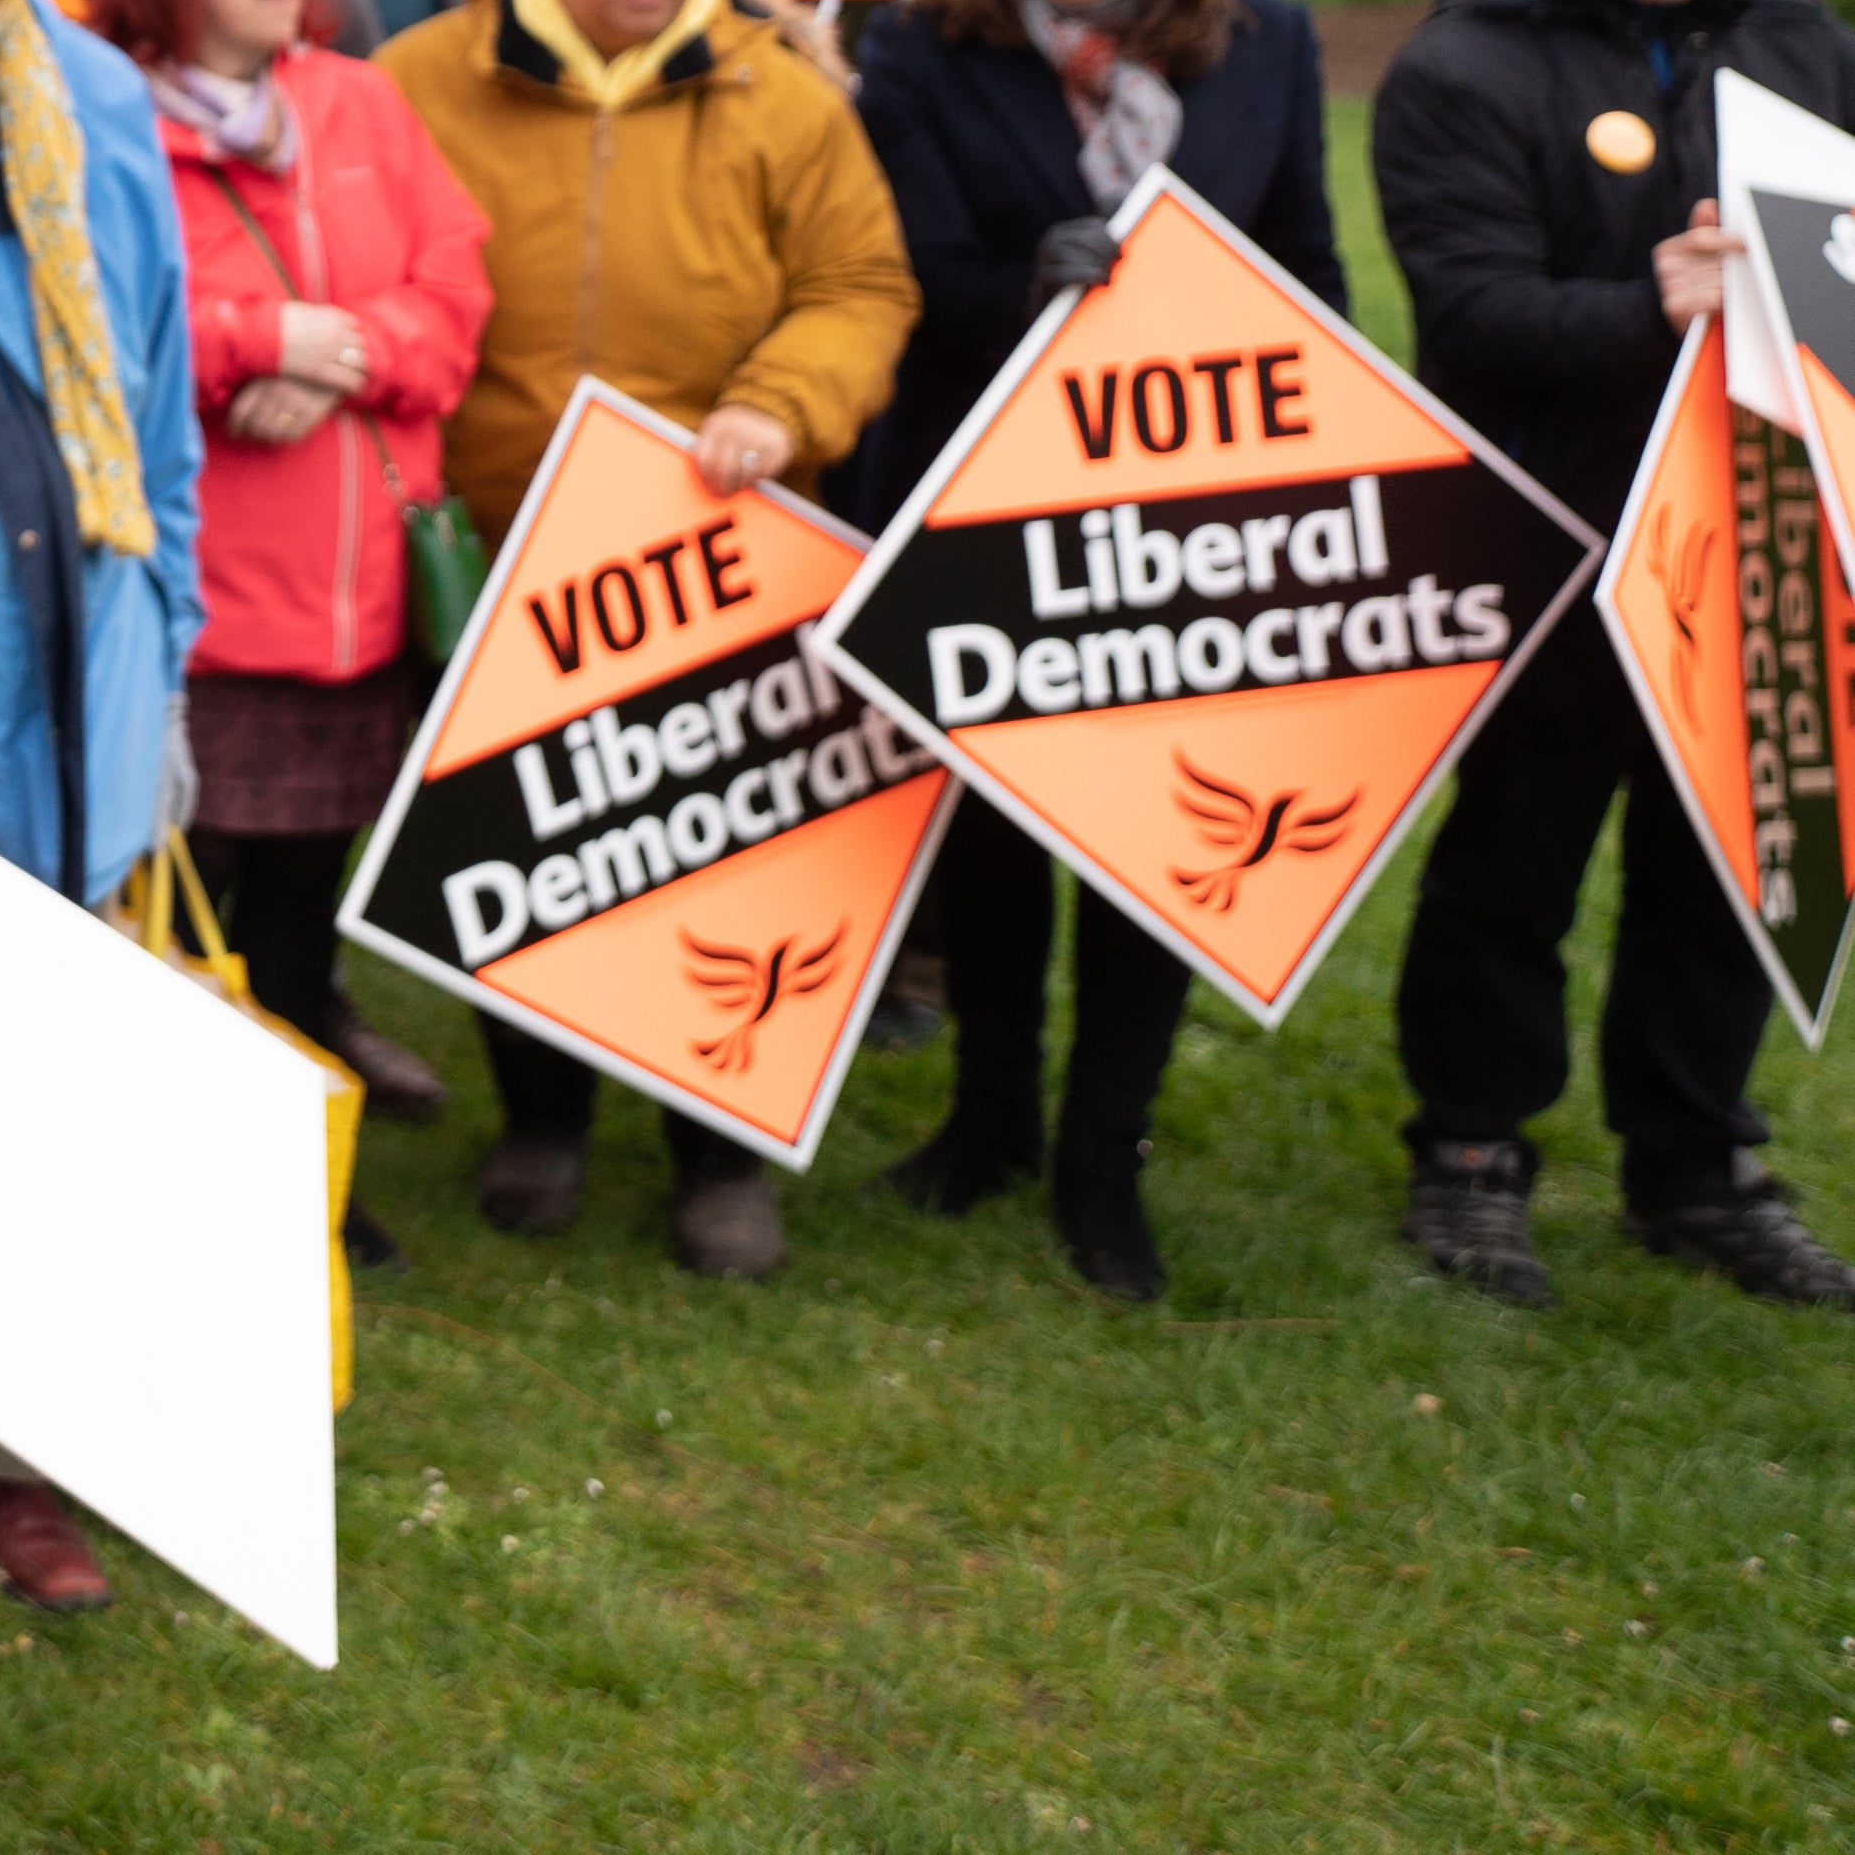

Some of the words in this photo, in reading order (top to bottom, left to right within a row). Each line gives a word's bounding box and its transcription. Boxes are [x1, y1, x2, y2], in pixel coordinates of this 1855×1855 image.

[1061, 345, 1311, 461] VOTE
[528, 513, 754, 675] VOTE
[1023, 474, 1391, 621] Liberal
[927, 574, 1512, 727] Democrats
[513, 620, 843, 842] Liberal
[442, 705, 942, 969] Democrat
